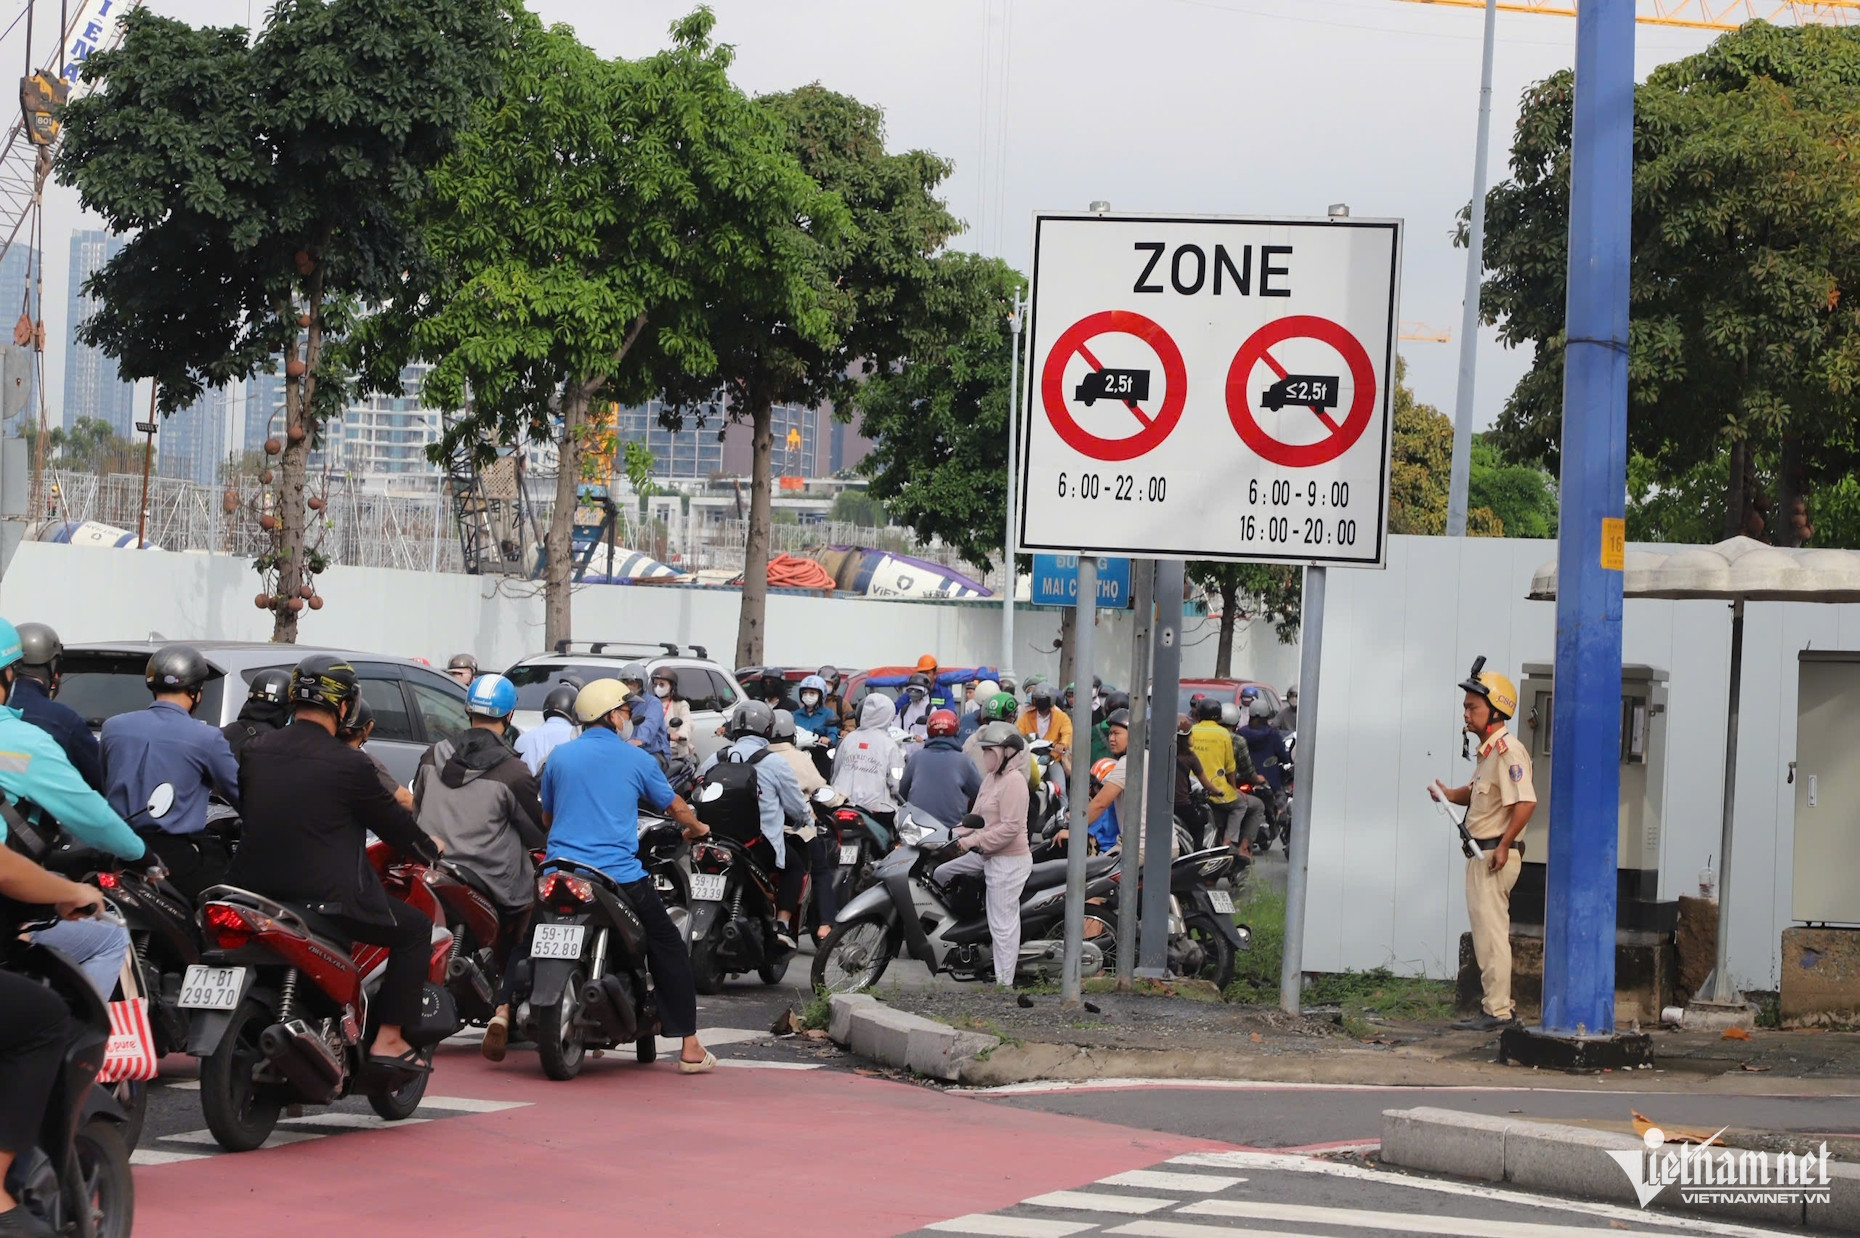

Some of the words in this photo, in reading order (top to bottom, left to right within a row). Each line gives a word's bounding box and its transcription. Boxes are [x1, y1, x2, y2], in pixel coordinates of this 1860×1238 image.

[1133, 242, 1293, 297] ZONE
[1104, 374, 1134, 394] 2,5t
[1042, 577, 1064, 595] MAI
[1096, 579, 1119, 602] THỌ
[695, 875, 720, 888] 59-T1
[541, 927, 575, 941] 59-Y1
[534, 941, 578, 956] 552.88
[193, 968, 233, 987] 71-B1
[183, 987, 235, 1006] 299.70
